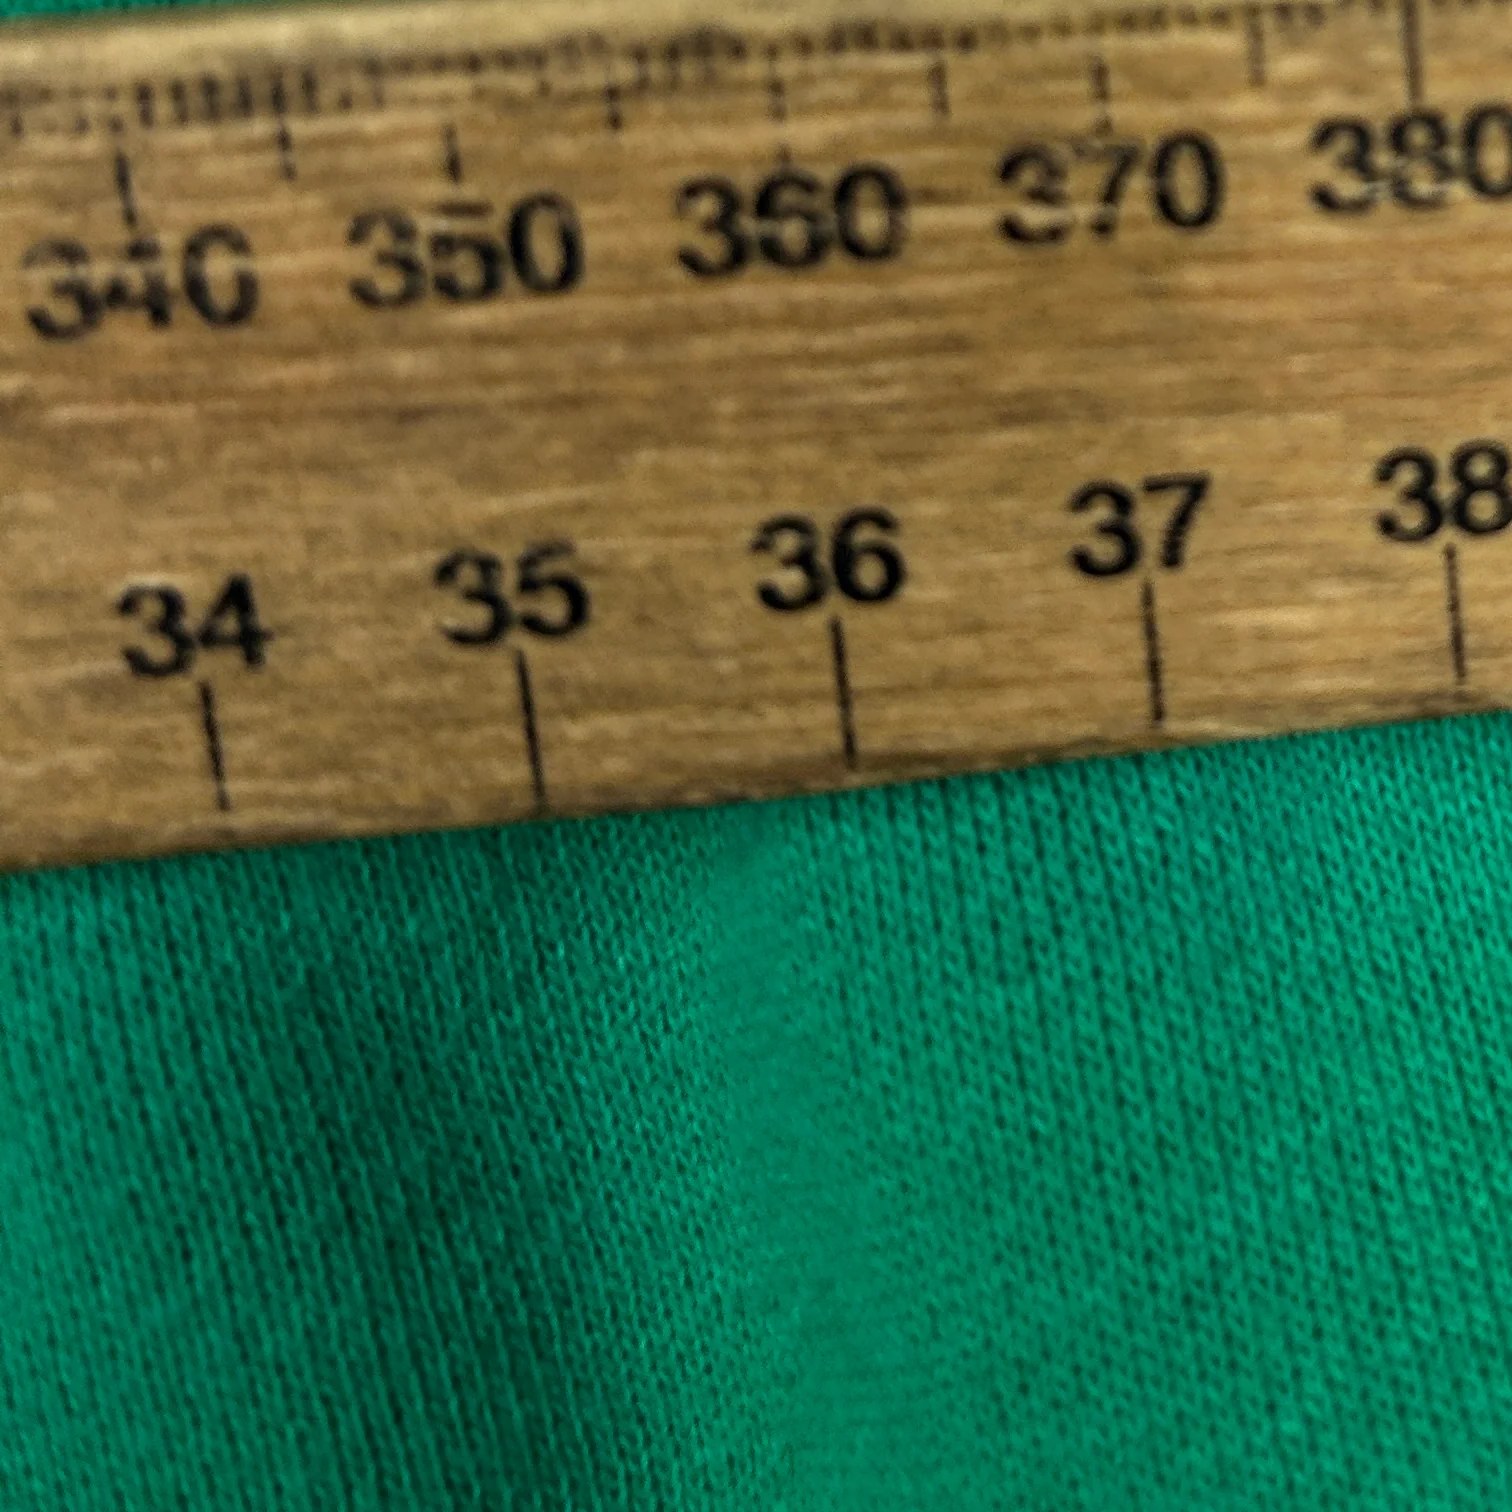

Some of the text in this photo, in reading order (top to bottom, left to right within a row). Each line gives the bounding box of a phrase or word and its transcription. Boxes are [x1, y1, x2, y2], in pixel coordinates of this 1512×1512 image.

[345, 192, 585, 309] 350
[676, 162, 909, 280] 360
[998, 130, 1226, 244] 370
[115, 573, 272, 677] 34
[433, 541, 590, 647] 35
[751, 508, 905, 612] 36
[1068, 472, 1211, 578] 37
